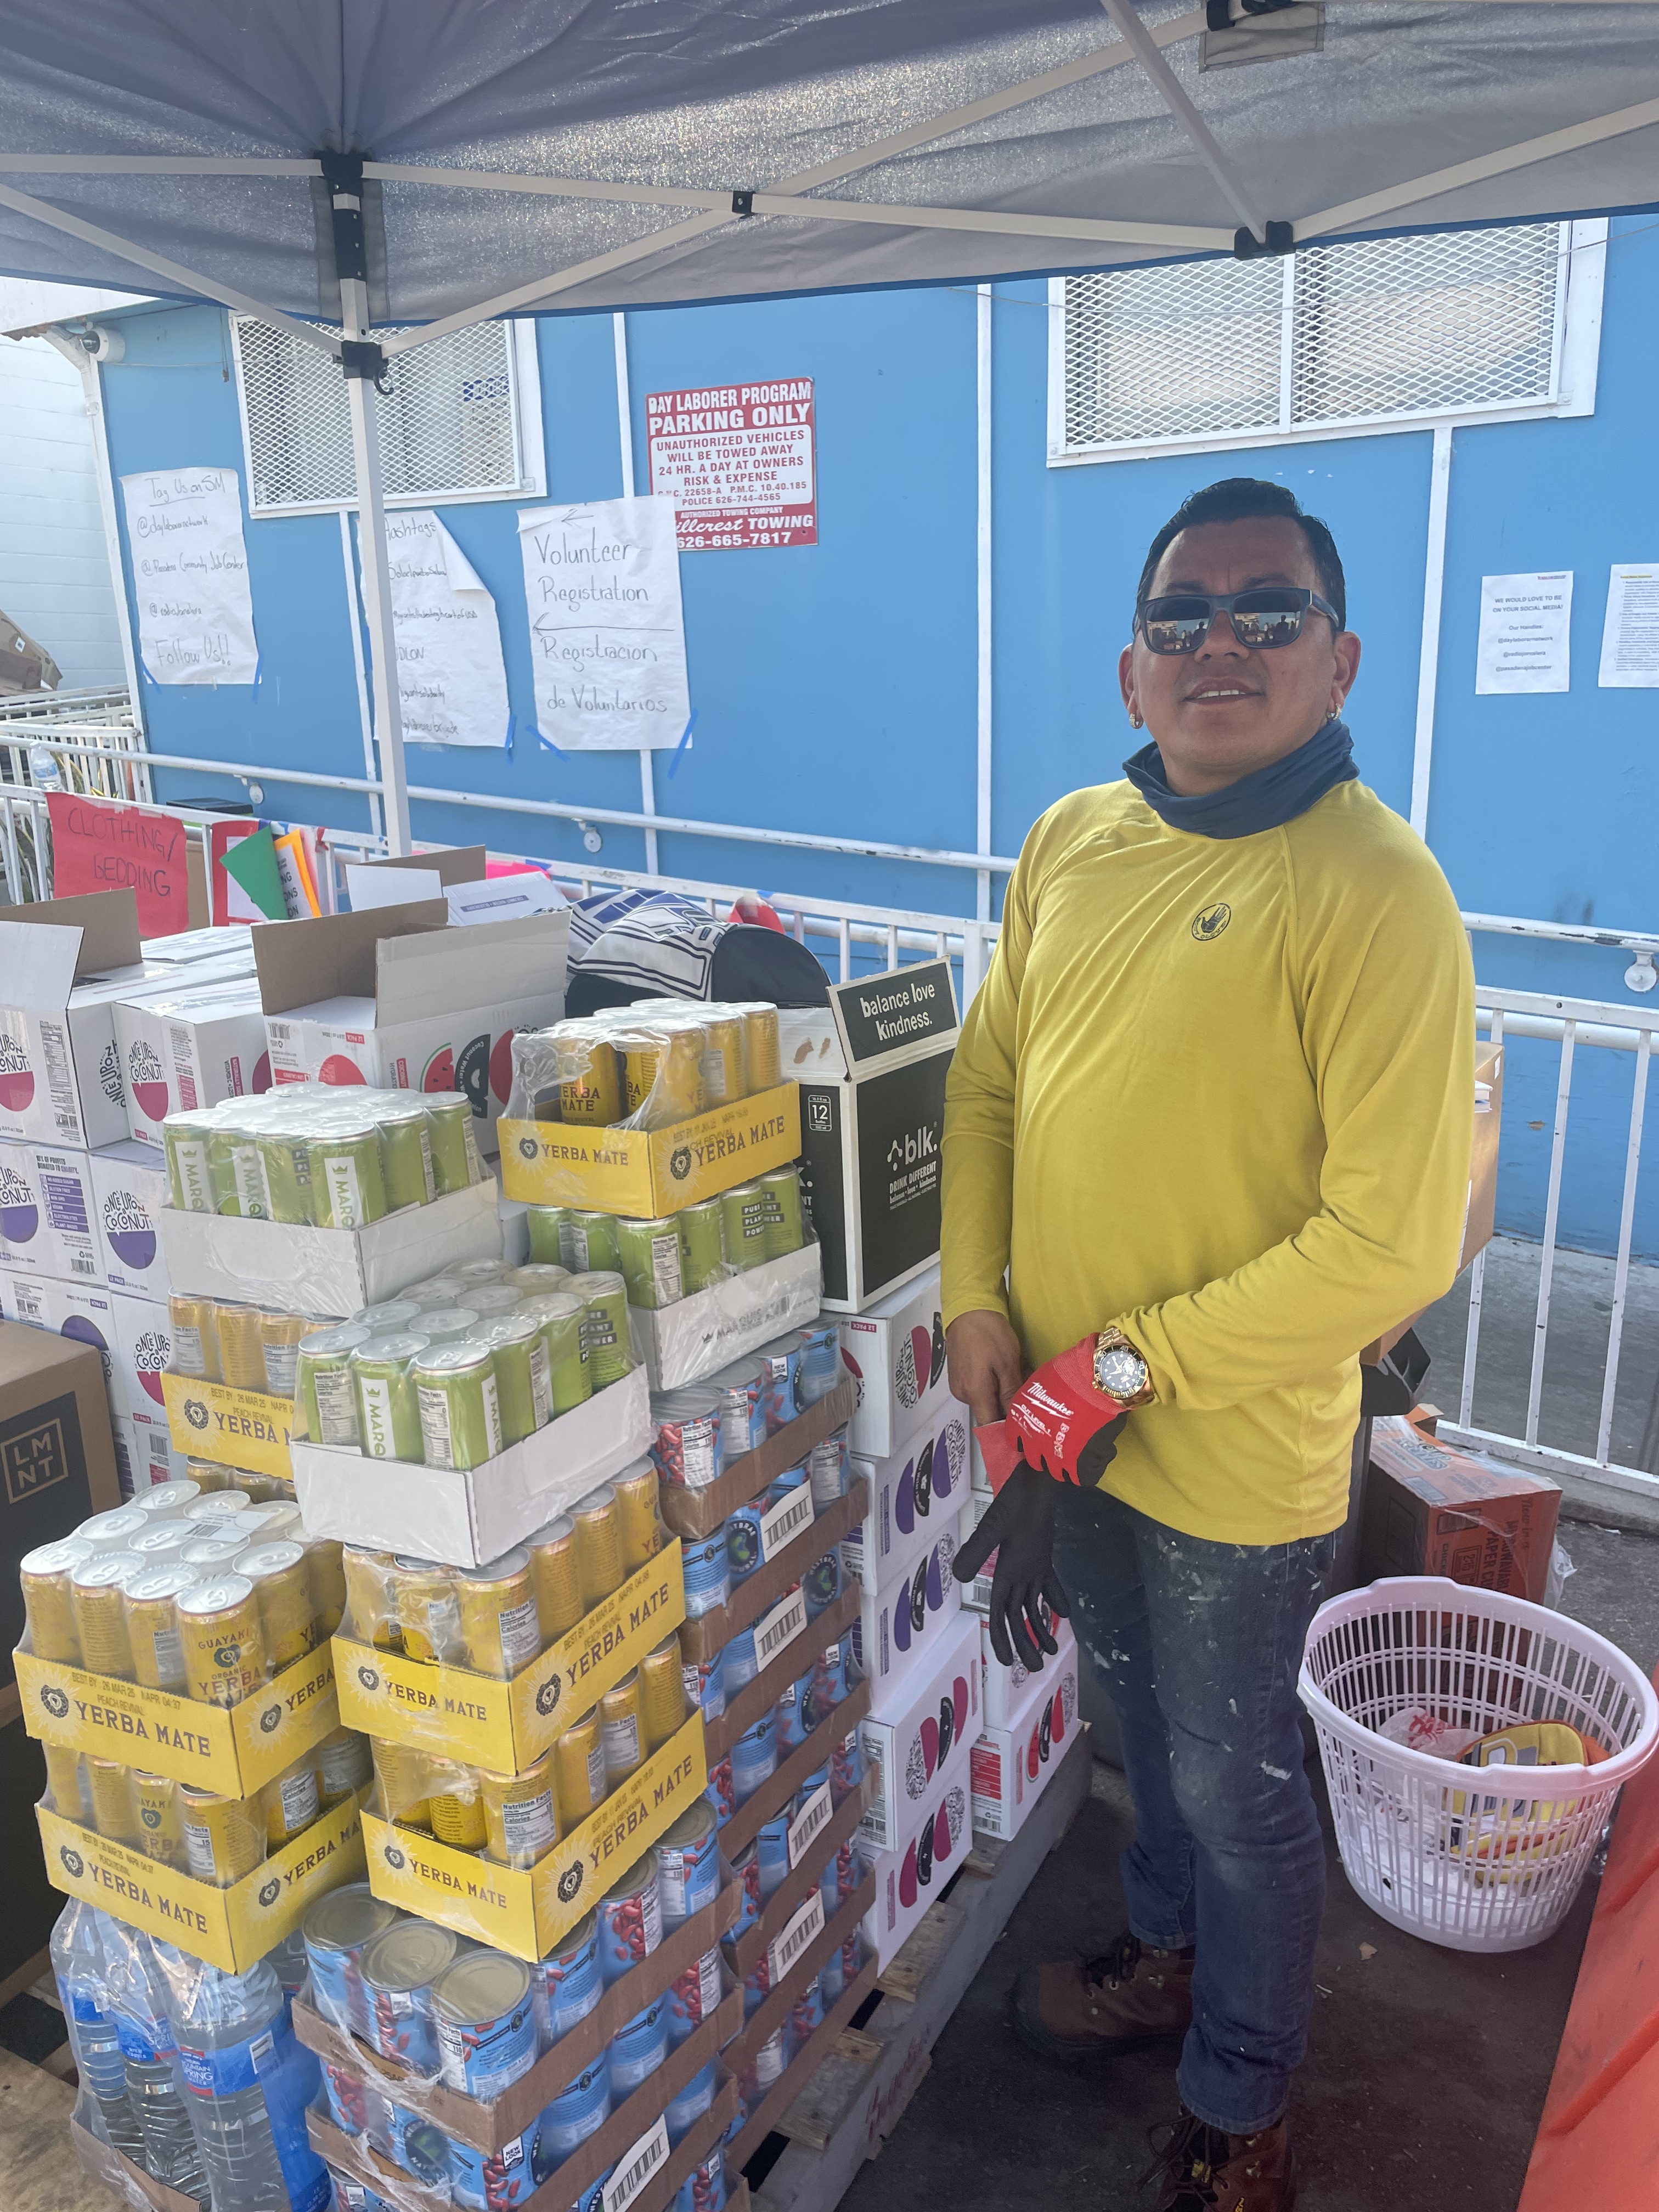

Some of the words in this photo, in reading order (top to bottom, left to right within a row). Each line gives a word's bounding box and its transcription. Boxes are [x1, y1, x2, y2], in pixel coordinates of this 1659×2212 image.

[649, 396, 673, 414] DAY
[676, 390, 737, 410] LABORER
[742, 382, 811, 405] PROGRAM
[650, 409, 744, 435] PARKING
[752, 403, 810, 426] ONLY
[657, 436, 742, 451] UNAUTHORIZED
[747, 430, 804, 443] VEHICLES
[668, 452, 693, 462] WILL
[698, 450, 712, 460] BE
[716, 448, 756, 459] TOWED
[761, 444, 793, 455] AWAY
[659, 466, 673, 475] 24
[676, 465, 695, 475] HR.
[699, 464, 706, 472] A
[711, 462, 730, 472] DAY
[735, 461, 748, 470] AT
[753, 456, 804, 469] OWNERS
[144, 477, 169, 502] Tag
[175, 478, 187, 493] Us
[204, 472, 225, 493] SM
[684, 477, 709, 486] RISK
[726, 471, 777, 483] EXPENSE
[685, 488, 721, 496] 22658-A
[730, 486, 757, 494] P.M.C.
[716, 493, 780, 504] 626-744-4565
[675, 518, 743, 533] illcrest
[748, 515, 814, 529] TOWING
[534, 527, 631, 565] Volunteer
[678, 532, 792, 549] 626-665-7817
[538, 575, 648, 612] Registration
[156, 637, 199, 667] Follow
[396, 647, 424, 661] DLON
[540, 634, 657, 672] Registracion
[548, 685, 566, 709] de
[571, 684, 667, 712] Voluntarios
[860, 990, 910, 1018] balance
[911, 983, 935, 1003] love
[876, 1011, 932, 1041] kindness.
[129, 1043, 140, 1064] ONCE
[142, 1042, 158, 1062] UPON
[131, 1062, 162, 1081] COCONUT
[460, 1060, 470, 1080] Water
[812, 1104, 828, 1119] 12
[695, 1136, 746, 1167] YERBA
[751, 1116, 785, 1144] MATE
[905, 1126, 937, 1165] blk.
[541, 1144, 589, 1162] YERBA
[593, 1149, 629, 1166] MATE
[185, 1164, 204, 1210] MARQ
[890, 1175, 907, 1194] DRINK
[909, 1161, 936, 1184] DIFFERENT
[104, 1192, 121, 1212] ONCE
[121, 1190, 145, 1215] UPON
[335, 1182, 355, 1229] MARQ
[105, 1214, 149, 1230] COCONUT
[136, 1332, 153, 1352] ONCE
[211, 1387, 224, 1399] BEST
[245, 1397, 258, 1407] MAR
[1027, 1382, 1072, 1416] Milwaukee
[213, 1411, 279, 1444] YERBA
[233, 1407, 252, 1419] PEACH
[252, 1412, 273, 1425] REVIVAL
[368, 1406, 386, 1457] MARQ
[1483, 1531, 1499, 1567] PAPER
[500, 1605, 529, 1619] Nutrition
[501, 1620, 527, 1632] Calories
[566, 1623, 625, 1688] YERBA
[630, 1582, 669, 1633] MATE
[199, 1628, 249, 1649] GUAYAKI
[72, 1672, 87, 1684] BEST
[89, 1677, 97, 1687] BY
[112, 1683, 126, 1695] MAR
[198, 1667, 261, 1695] YERBA
[211, 1665, 247, 1680] ORGANIC
[284, 1668, 335, 1715] YERBA
[382, 1681, 437, 1708] YERBA
[445, 1699, 487, 1722] MATE
[97, 1694, 119, 1709] PEACH
[119, 1702, 145, 1716] REVIVAL
[74, 1700, 150, 1740] YERBA
[154, 1723, 211, 1757] MATE
[503, 1799, 535, 1810] Nutrition
[535, 1790, 552, 1802] Facts
[589, 1802, 650, 1870] YERBA
[653, 1754, 692, 1809] MATE
[504, 1815, 531, 1824] Calories
[281, 1839, 337, 1887] YERBA
[408, 1861, 461, 1892] YERBA
[467, 1880, 508, 1909] MATE
[88, 1861, 153, 1907] YERBA
[158, 1895, 208, 1934] MATE
[184, 2068, 213, 2080] SPRING
[505, 2150, 521, 2160] LOOK
[506, 2145, 520, 2155] NEW
